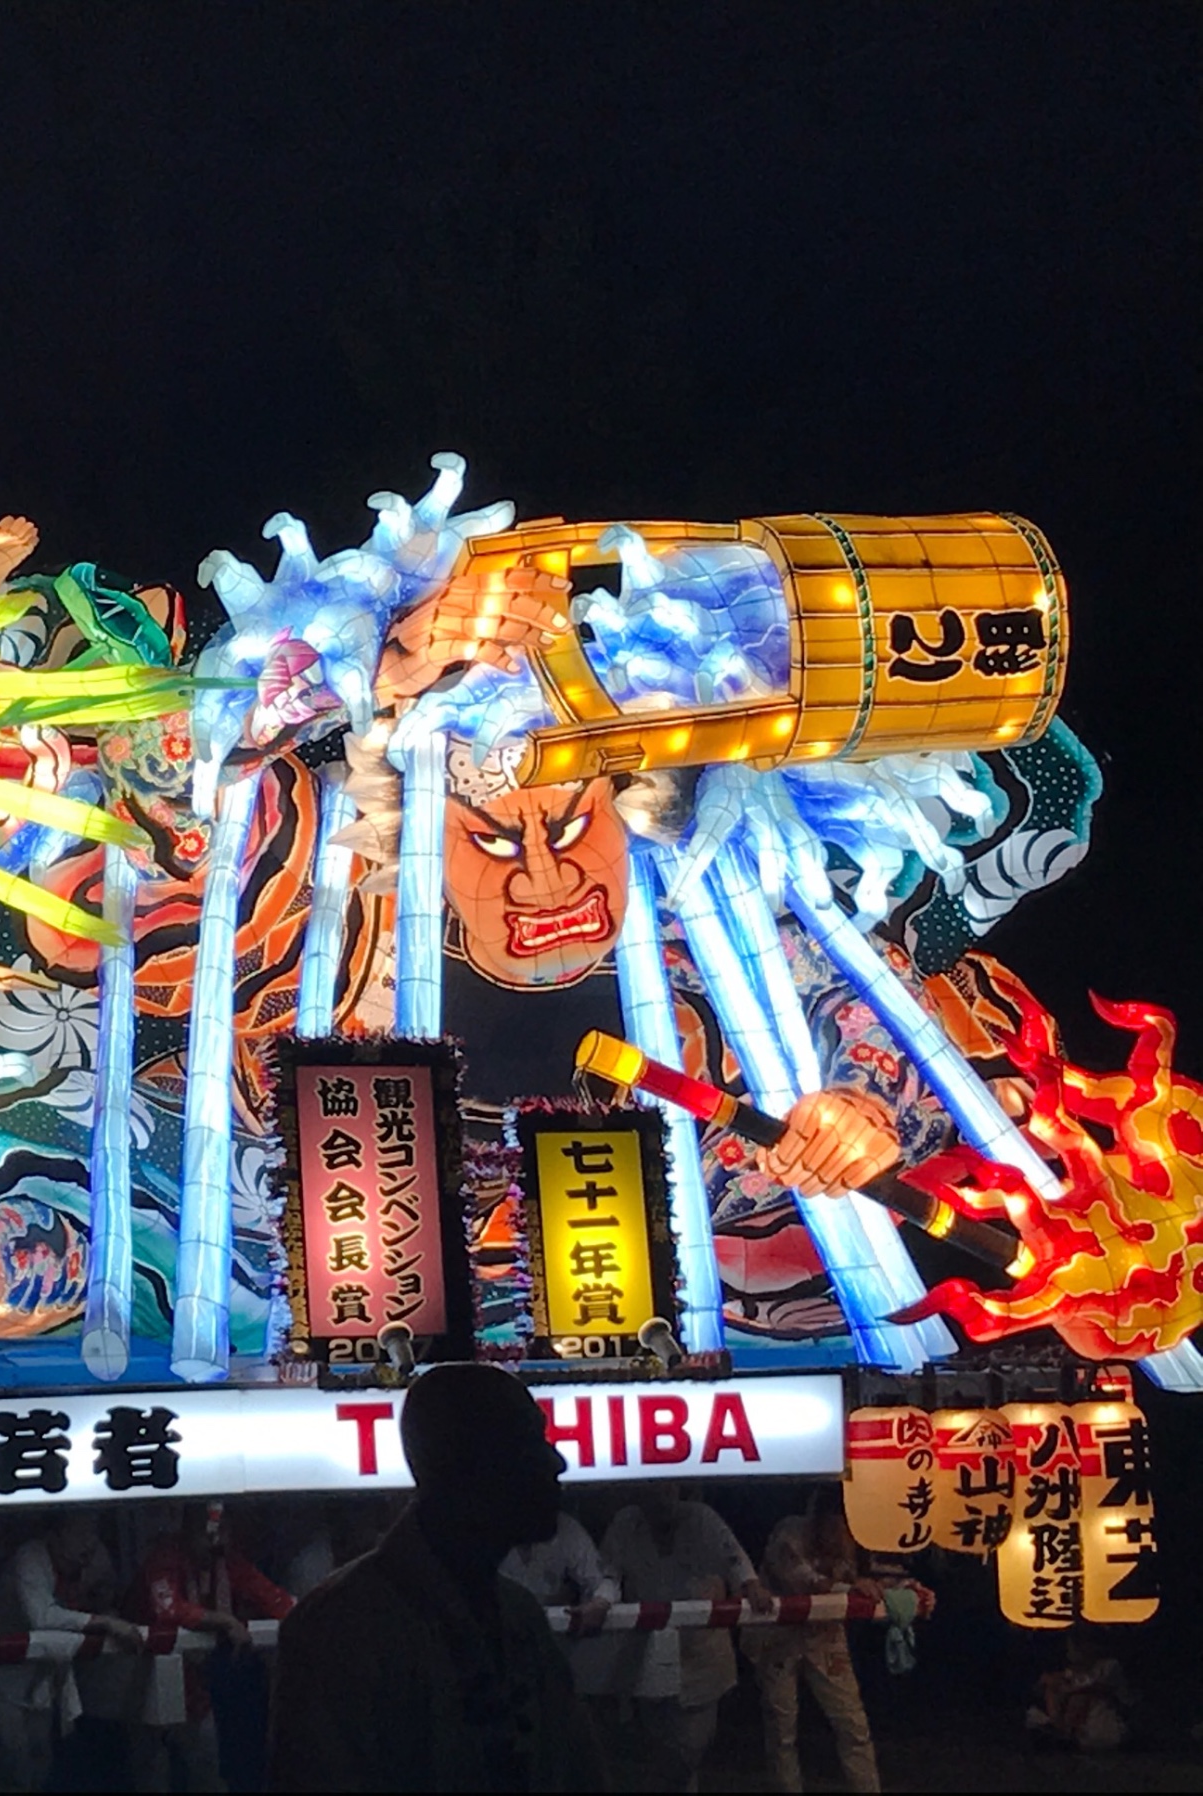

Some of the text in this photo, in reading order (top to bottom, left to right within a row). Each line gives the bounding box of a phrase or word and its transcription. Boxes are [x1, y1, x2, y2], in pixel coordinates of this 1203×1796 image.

[316, 1077, 374, 1326] 協会会長賞
[371, 1077, 426, 1322] 観光コンベンション
[561, 1140, 626, 1326] 七十一年賞
[336, 1392, 761, 1476] THIBA
